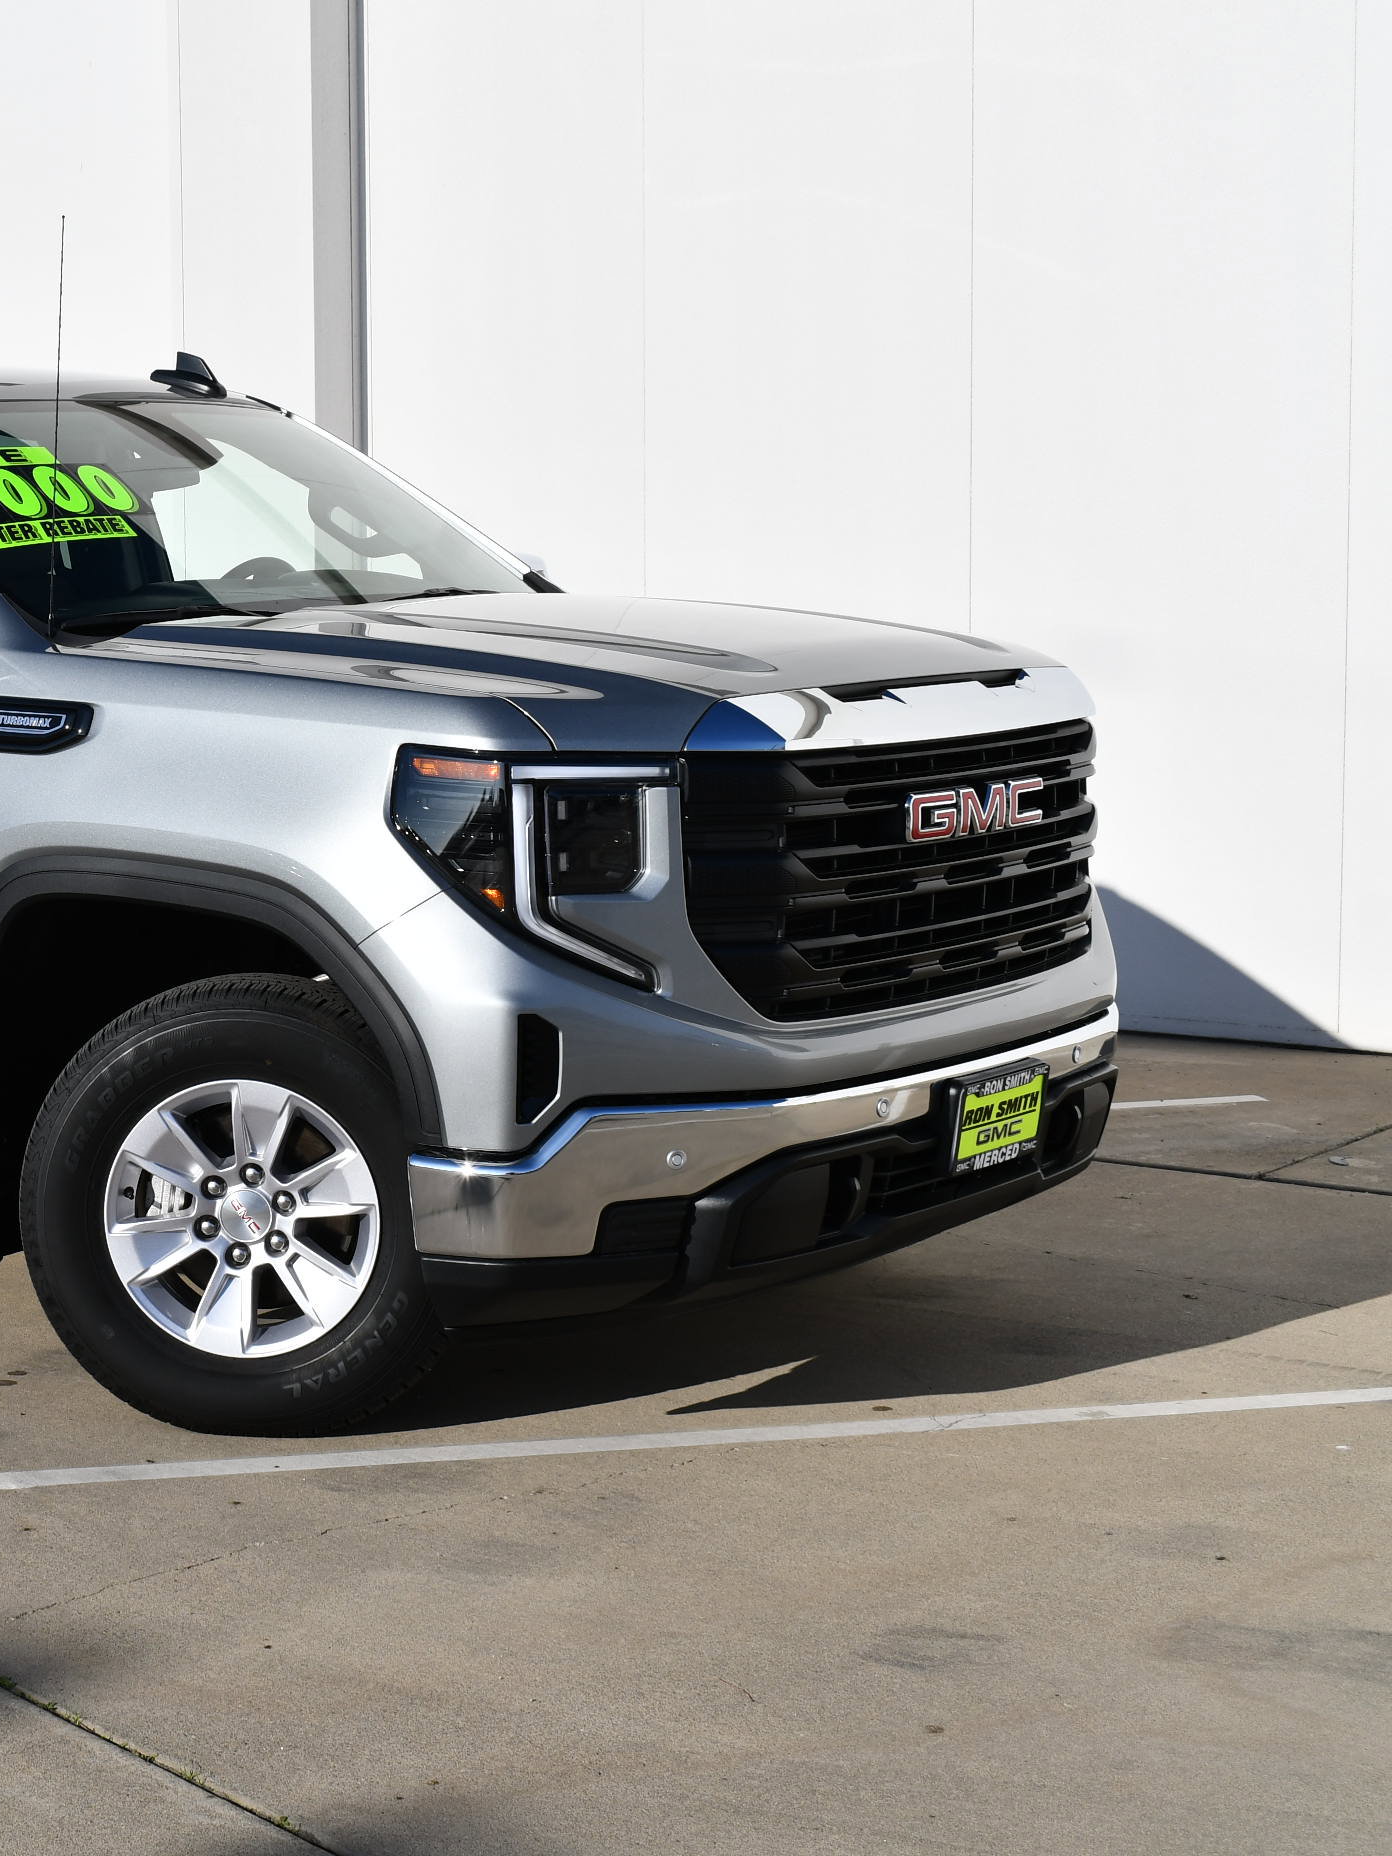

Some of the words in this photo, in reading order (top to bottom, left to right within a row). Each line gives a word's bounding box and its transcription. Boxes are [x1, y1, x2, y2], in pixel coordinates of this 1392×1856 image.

[41, 515, 128, 538] REBATE
[905, 777, 1044, 843] GMC
[983, 1079, 1004, 1096] RON
[1004, 1071, 1031, 1090] SMITH
[962, 1103, 994, 1127] RON
[995, 1091, 1039, 1118] SMITH
[976, 1119, 1023, 1146] GMC
[973, 1143, 1019, 1171] MERCED
[230, 1199, 261, 1234] GMC
[282, 1291, 409, 1400] GENERAL
